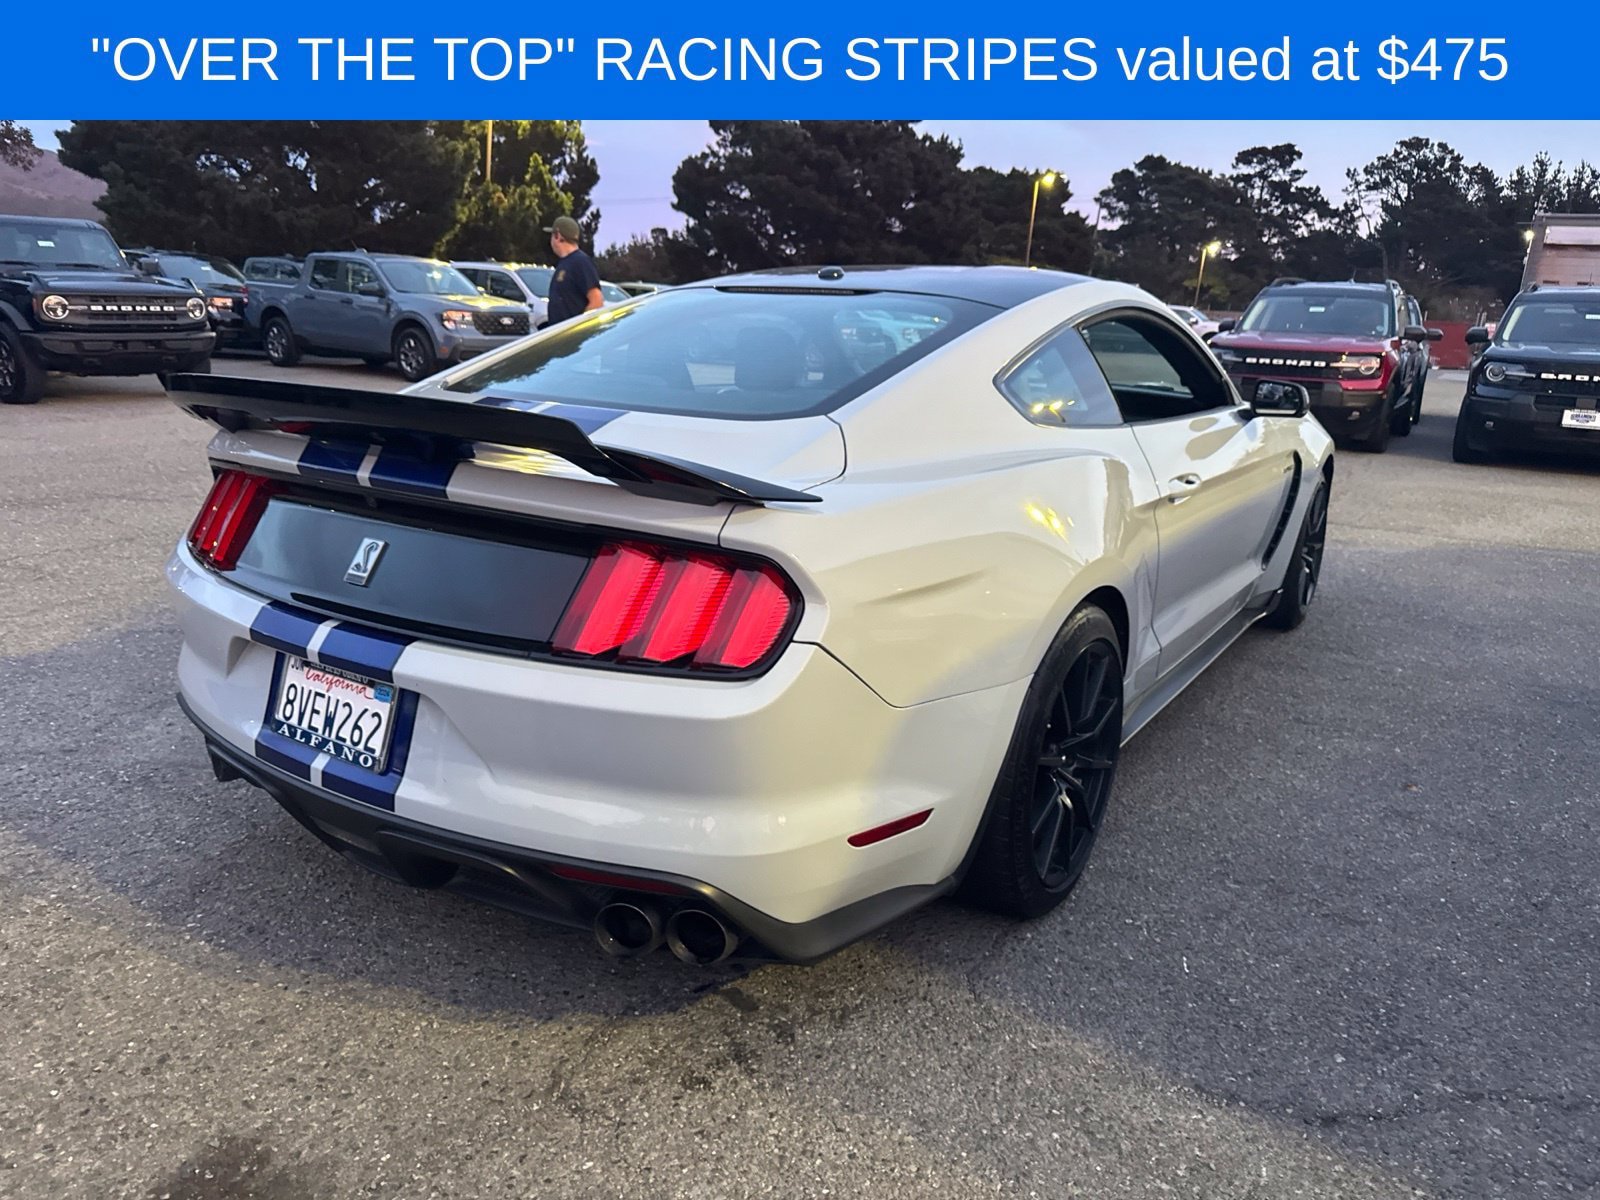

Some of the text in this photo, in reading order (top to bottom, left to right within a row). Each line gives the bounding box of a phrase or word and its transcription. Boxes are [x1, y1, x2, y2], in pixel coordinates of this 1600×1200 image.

[1245, 357, 1327, 368] BRONCO
[305, 667, 374, 700] California
[282, 683, 383, 755] 8VEW262
[277, 723, 373, 768] ALFANO
